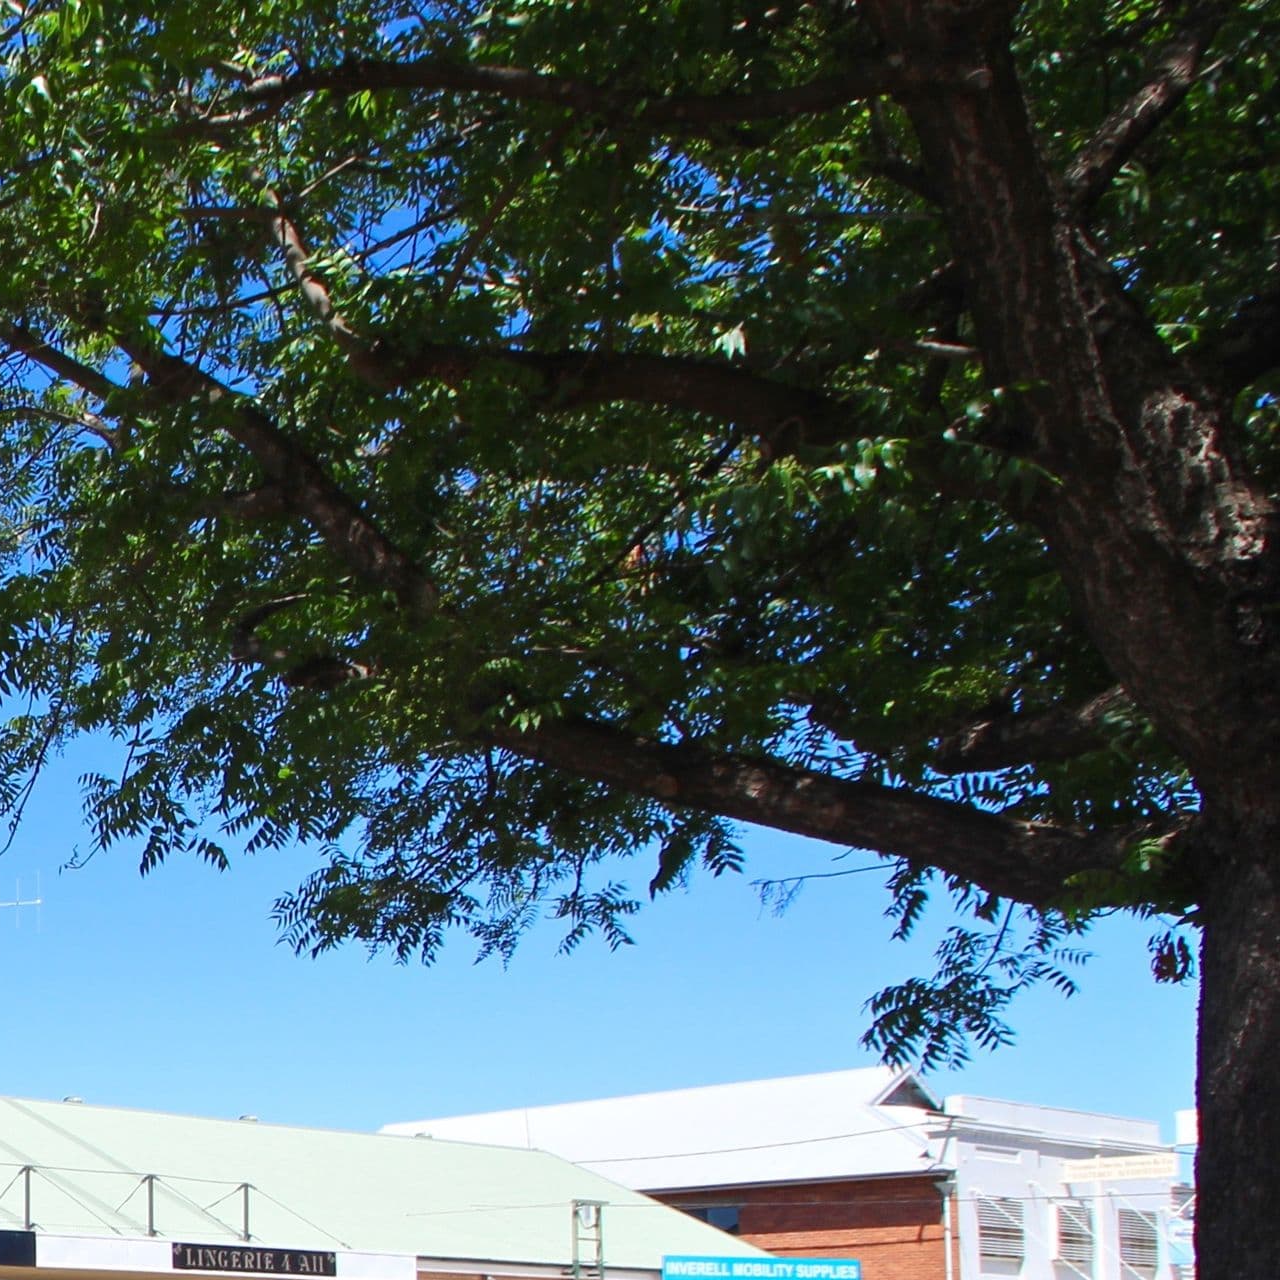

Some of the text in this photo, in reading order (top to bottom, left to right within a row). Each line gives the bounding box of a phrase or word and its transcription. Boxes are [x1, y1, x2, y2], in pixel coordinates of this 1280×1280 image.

[185, 1248, 275, 1270] LINGERIE
[281, 1254, 290, 1271] 4
[666, 1261, 857, 1280] INVERELL MOBILITY SUPPLIES
